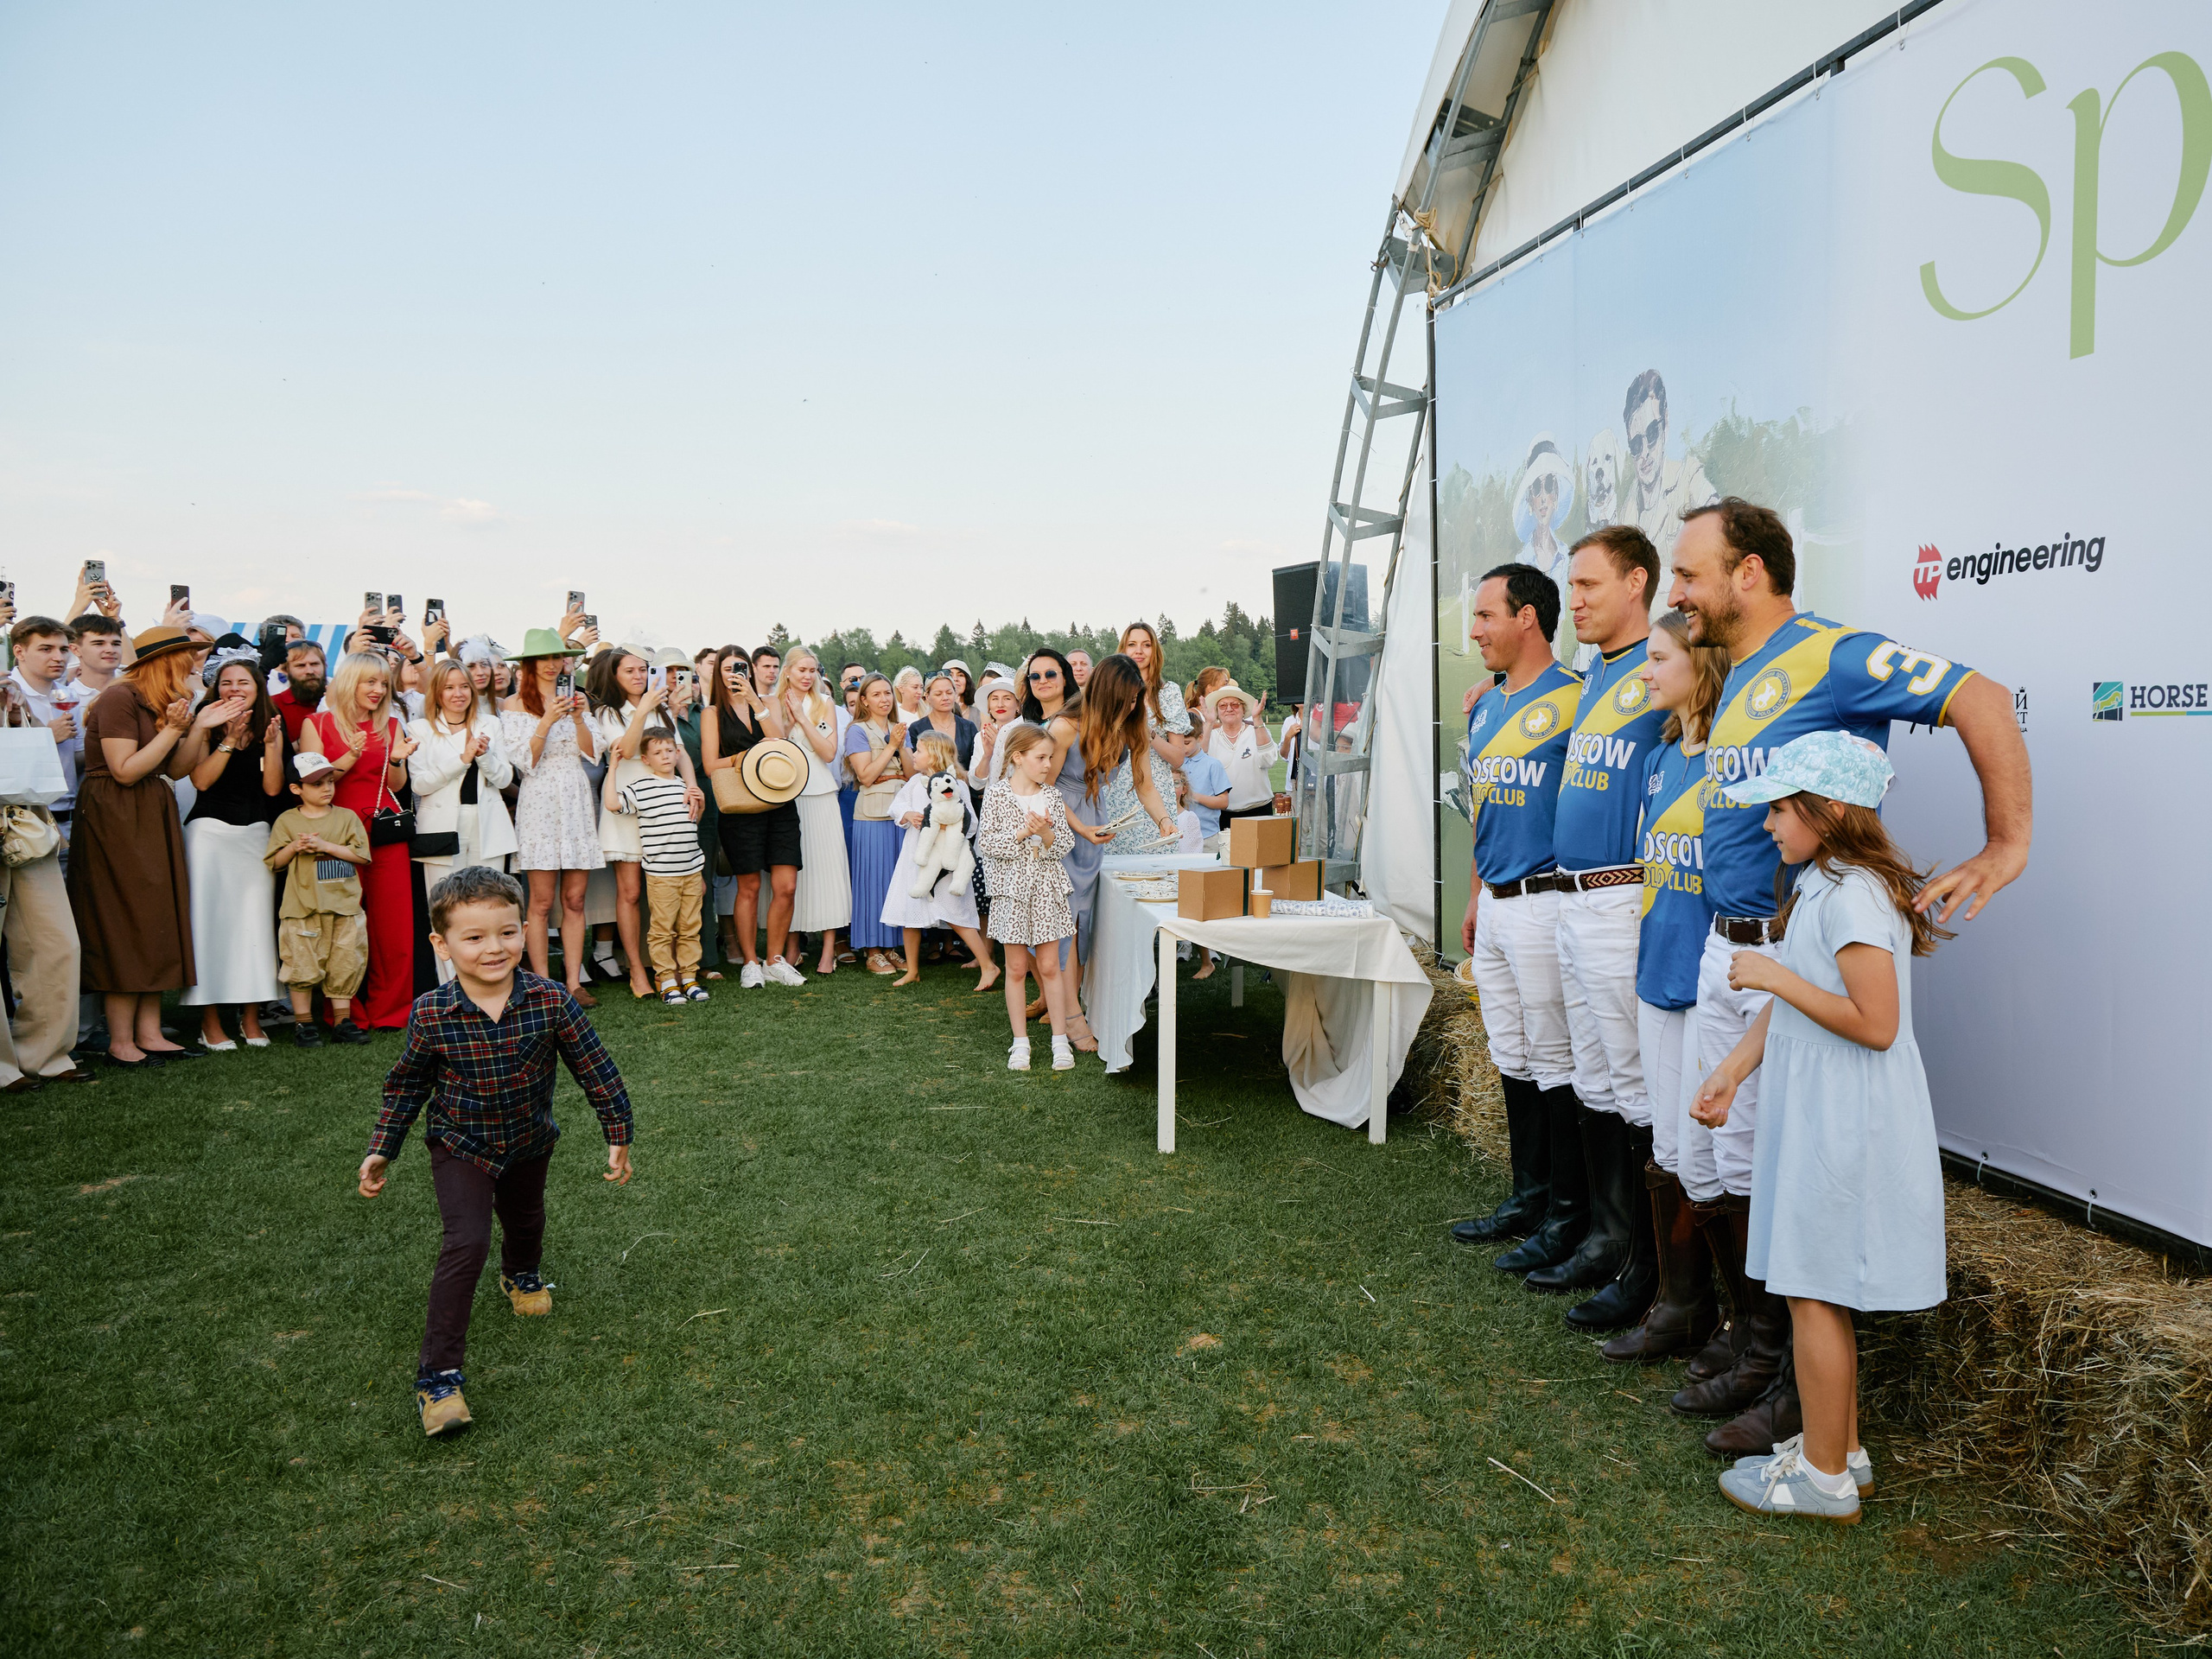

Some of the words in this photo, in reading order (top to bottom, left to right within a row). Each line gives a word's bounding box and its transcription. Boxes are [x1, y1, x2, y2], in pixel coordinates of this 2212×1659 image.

[1946, 531, 2107, 585] engineering
[1866, 640, 1952, 696] 3
[1772, 698, 1784, 711] CLUB
[2130, 683, 2208, 709] HORSE
[1566, 731, 1637, 770] OSCOW
[1705, 747, 1780, 782] SCOW
[1570, 766, 1610, 791] CLUB
[1488, 787, 1526, 806] CLUB
[1643, 831, 1703, 869] OSCO
[1643, 867, 1666, 888] OLO
[1667, 870, 1703, 895] CLUB
